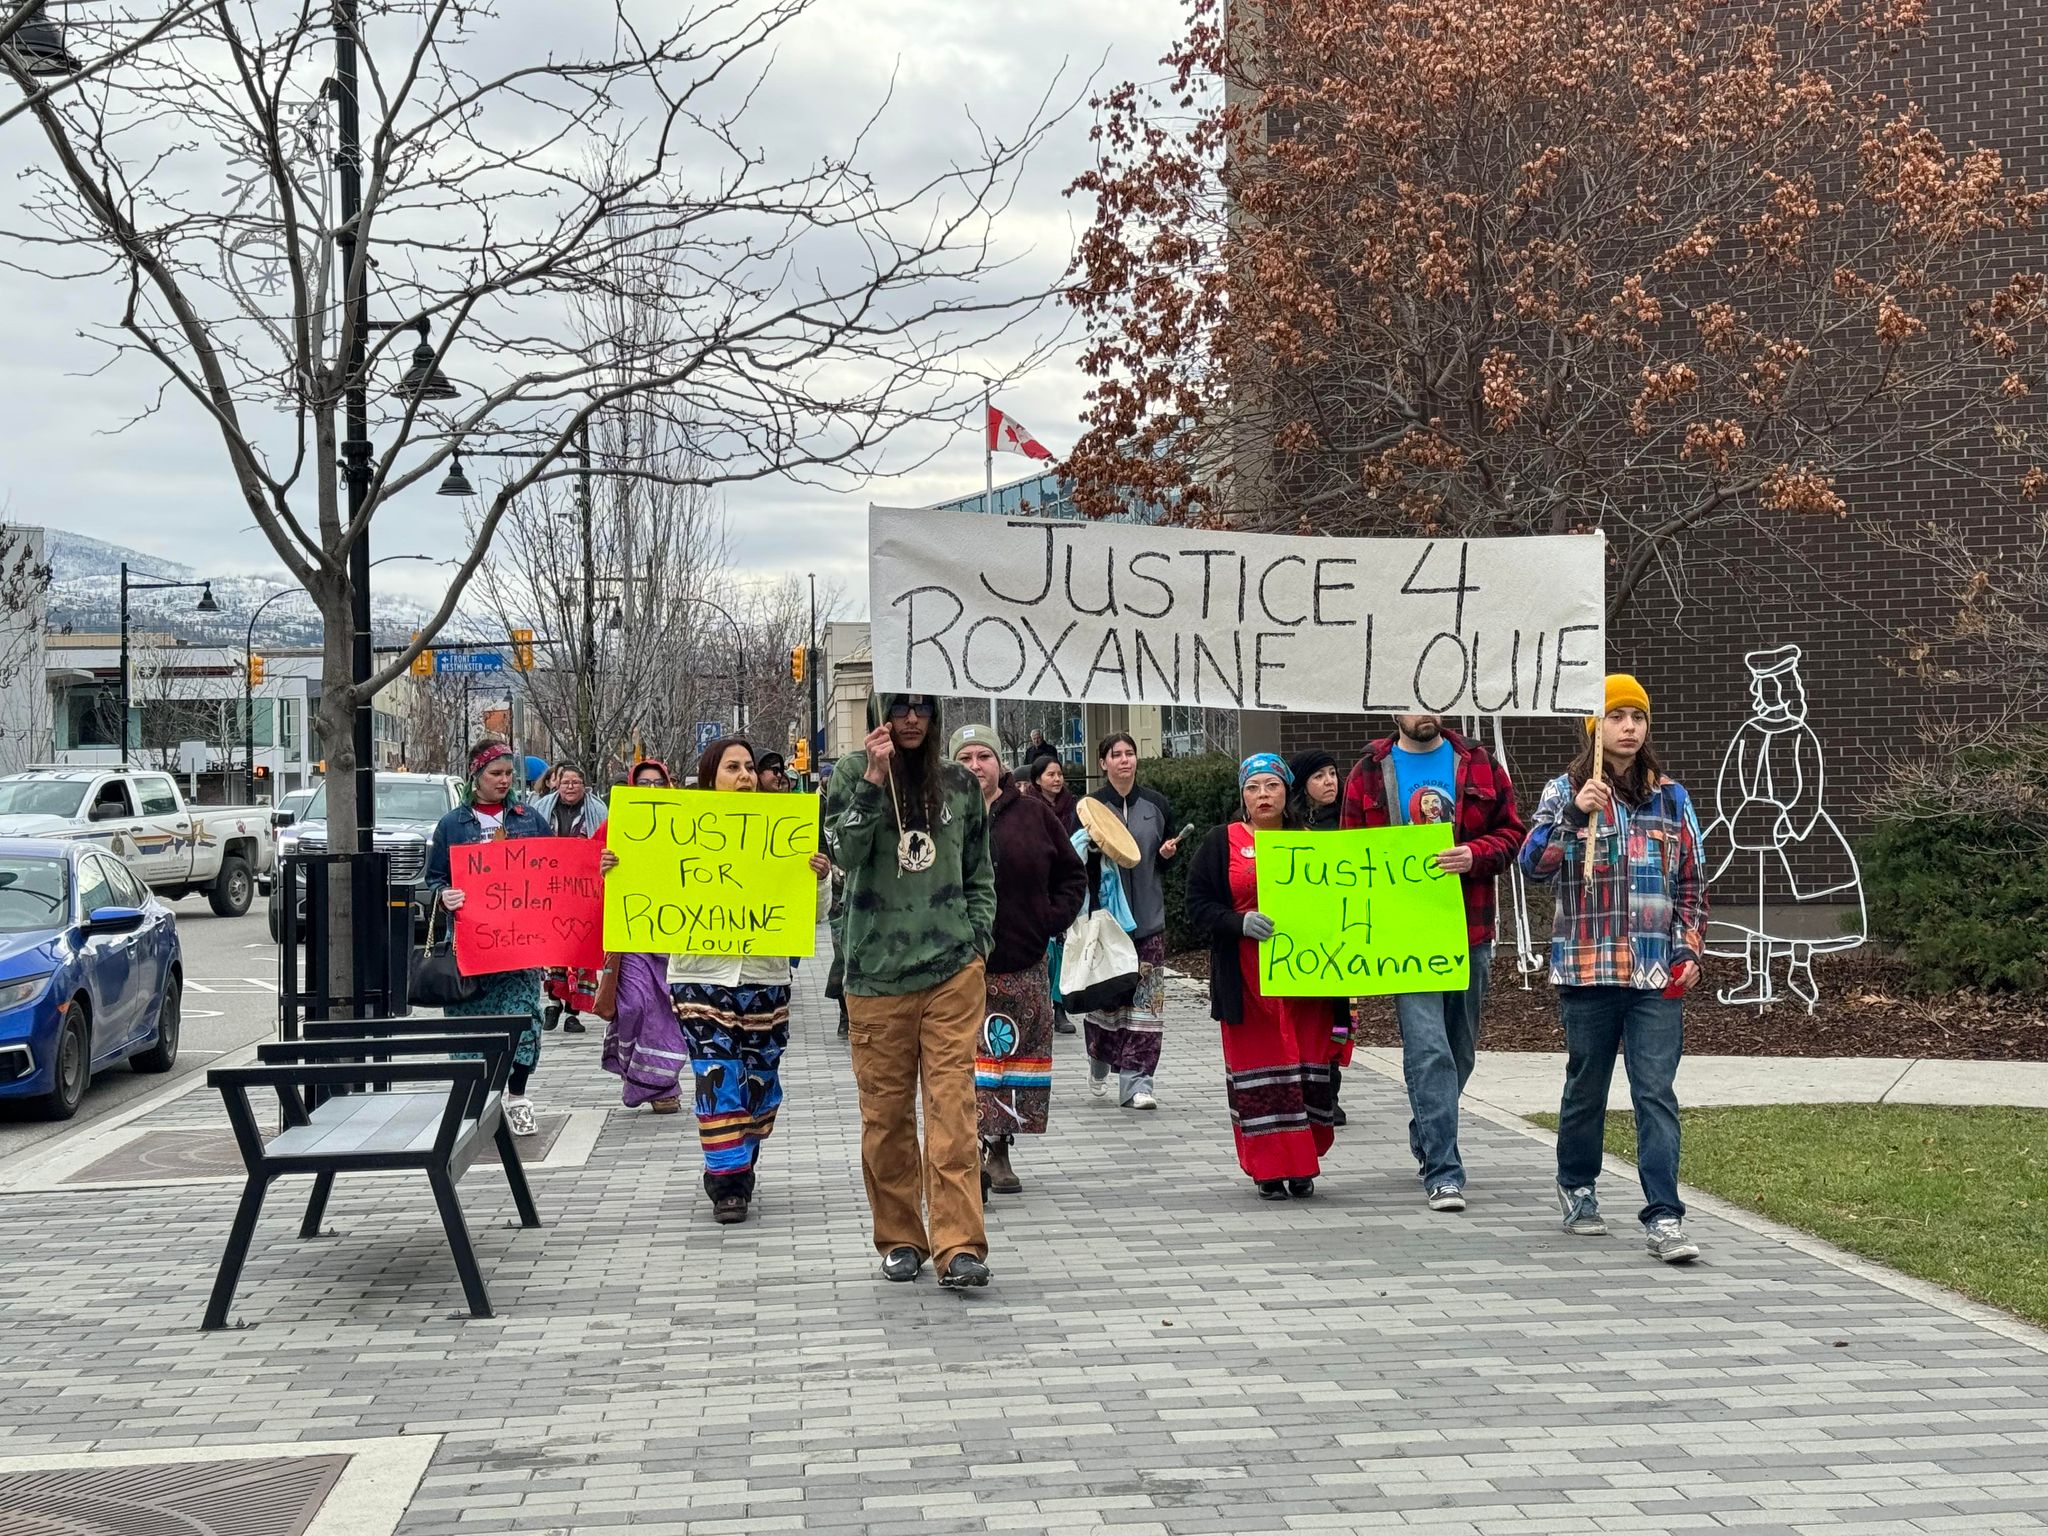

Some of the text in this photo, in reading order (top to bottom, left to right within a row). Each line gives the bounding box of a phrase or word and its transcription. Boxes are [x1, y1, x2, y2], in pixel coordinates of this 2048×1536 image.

[979, 520, 1481, 637] JUSTICE 4
[441, 663, 483, 671] WESTMINSTER
[891, 585, 1600, 715] ROXANNE LOUIE
[623, 800, 814, 861] JUSTICE
[468, 845, 559, 876] No More
[679, 856, 744, 889] FOR
[1272, 845, 1449, 888] Justice
[485, 879, 552, 912] Stolen
[475, 921, 546, 950] Sisters
[623, 893, 786, 942] ROXANNE
[1341, 896, 1373, 945] 4
[686, 935, 757, 954] LOUIE
